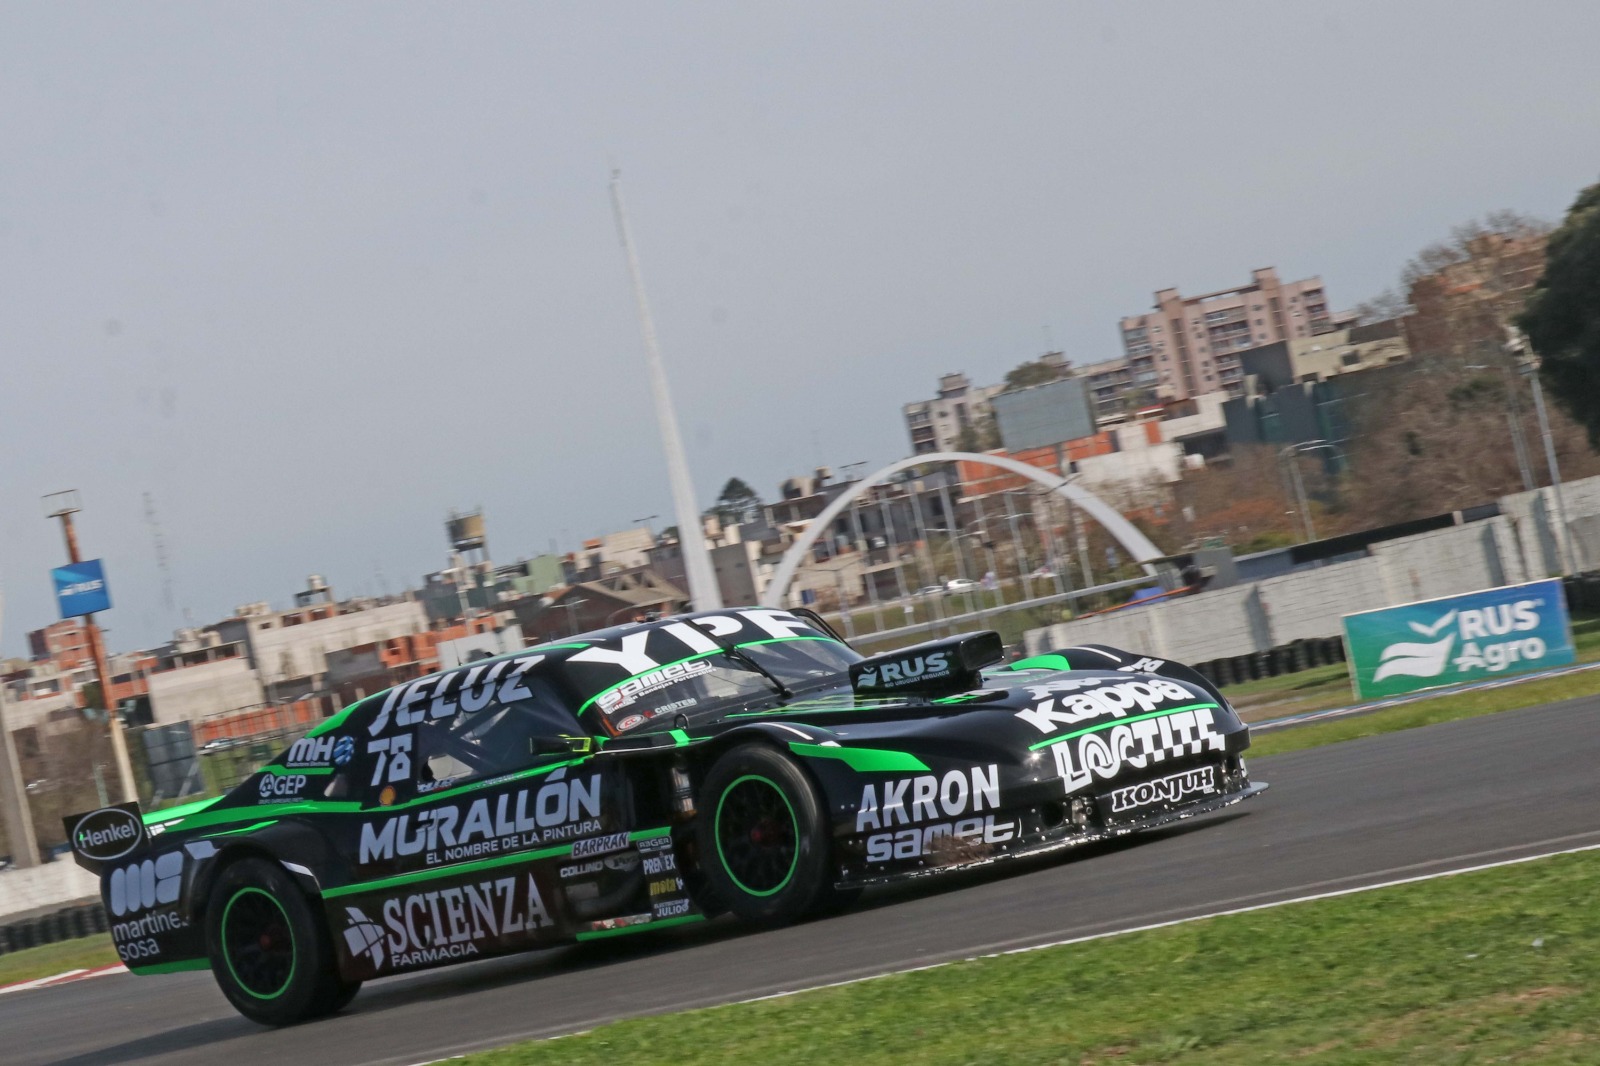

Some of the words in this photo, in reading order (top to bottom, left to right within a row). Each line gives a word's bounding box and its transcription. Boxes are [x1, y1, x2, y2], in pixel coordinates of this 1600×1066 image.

[566, 609, 811, 676] YPF
[1458, 600, 1540, 640] RUS
[880, 652, 949, 682] RUS
[1452, 637, 1546, 671] Agro
[367, 655, 546, 737] JELUZ
[598, 659, 708, 707] samet
[654, 697, 698, 715] CRISTEM
[1014, 678, 1196, 734] Kappa
[367, 733, 413, 786] 78
[1051, 708, 1226, 794] LOCTITE
[856, 764, 1000, 832] AKRON
[1112, 766, 1215, 812] KONJUH
[79, 819, 136, 849] Henkel
[359, 767, 602, 865] MURALLÓN
[866, 815, 1015, 863] samet
[426, 853, 440, 865] EL
[445, 839, 499, 860] NOMBRE
[502, 834, 520, 848] DE
[522, 830, 539, 844] LA
[543, 820, 602, 840] PINTURA
[572, 834, 629, 858] BARPRAN
[383, 872, 554, 953] SCIENZA
[118, 938, 161, 961] sosa
[391, 941, 478, 967] FARMACIA
